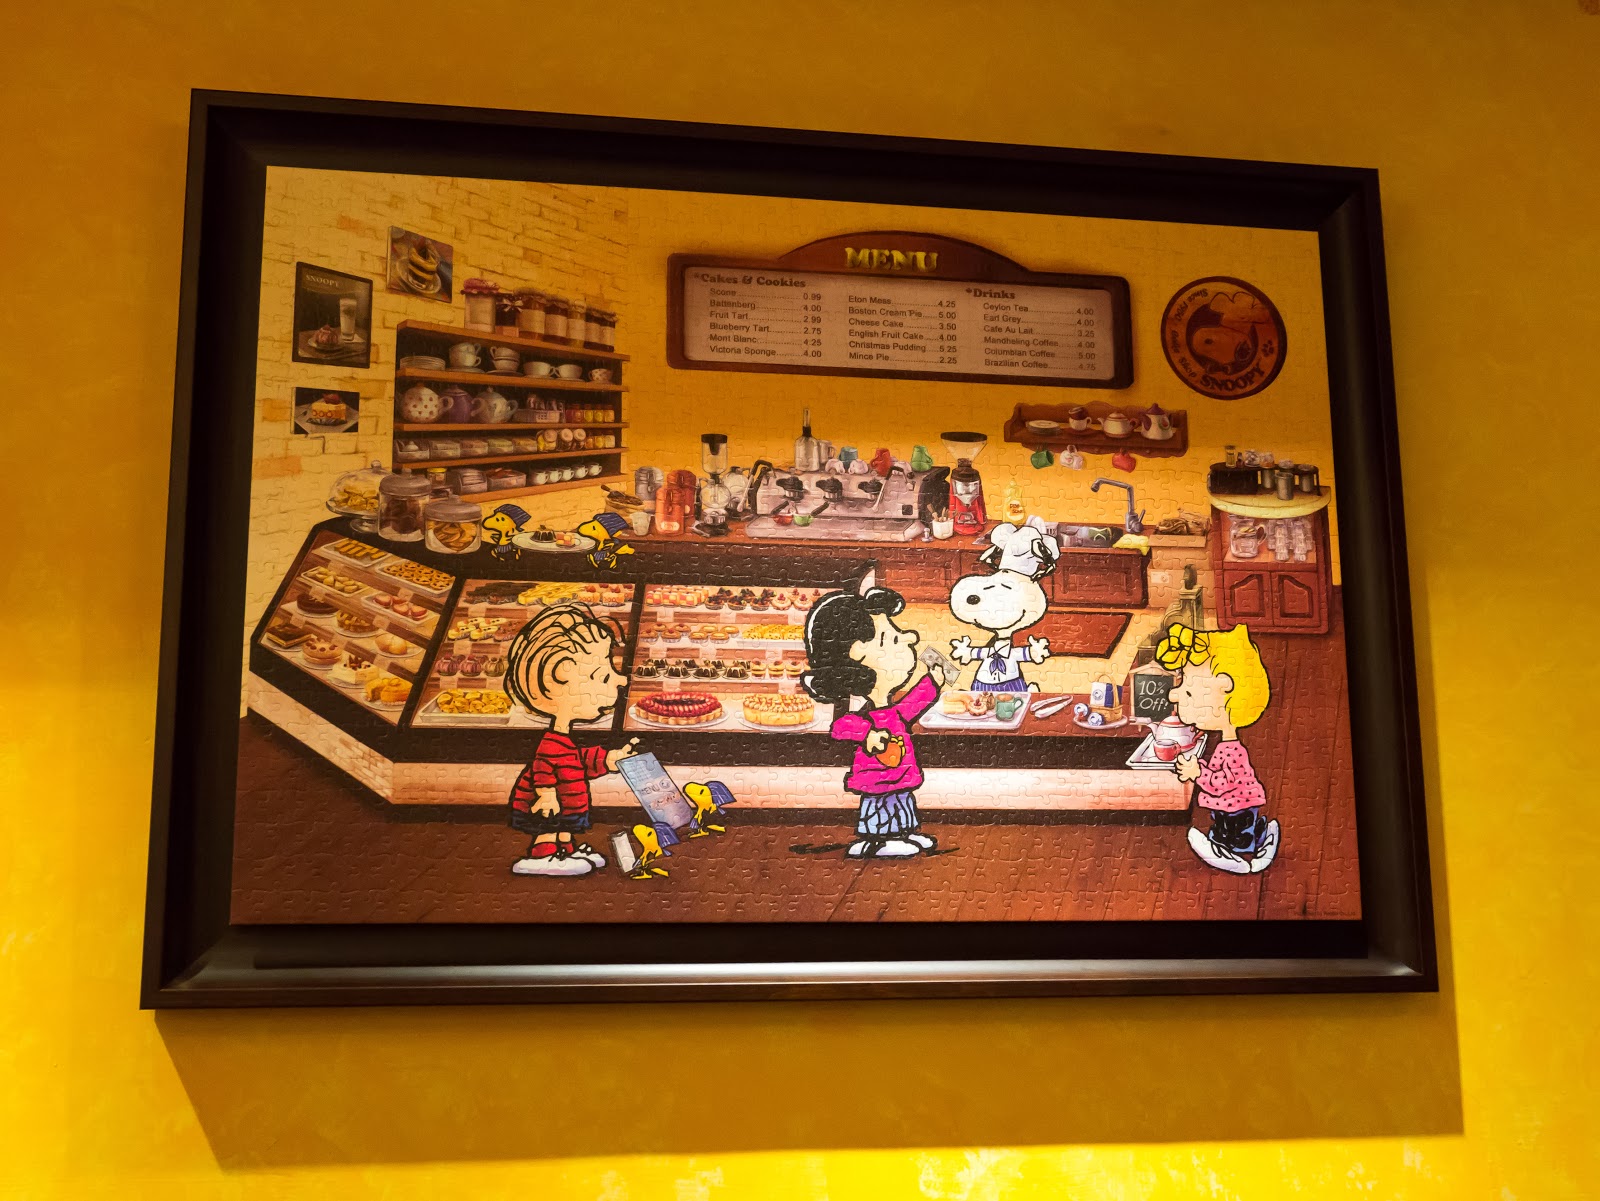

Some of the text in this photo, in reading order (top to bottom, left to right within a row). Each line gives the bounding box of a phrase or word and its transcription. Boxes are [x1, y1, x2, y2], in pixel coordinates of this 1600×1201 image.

[845, 247, 938, 271] MENU
[306, 275, 339, 287] SNOOPY
[702, 273, 806, 287] Cakes & Cookies
[974, 289, 1015, 299] Drinks
[710, 300, 756, 310] Battenberg
[983, 303, 1011, 312] Ceylon
[848, 318, 880, 326] Cheese
[1002, 315, 1022, 324] Grey
[710, 323, 750, 332] Blueberry
[849, 330, 879, 338] English
[710, 346, 741, 354] Victoria
[745, 348, 776, 357] Sponge
[849, 341, 890, 349] Christmas
[893, 343, 926, 352] Pudding
[985, 359, 1019, 367] Brazilian
[1022, 360, 1048, 369] Coffee
[1200, 359, 1264, 391] SNOOPY
[1138, 680, 1166, 695] 10%
[1140, 698, 1168, 711] Off!
